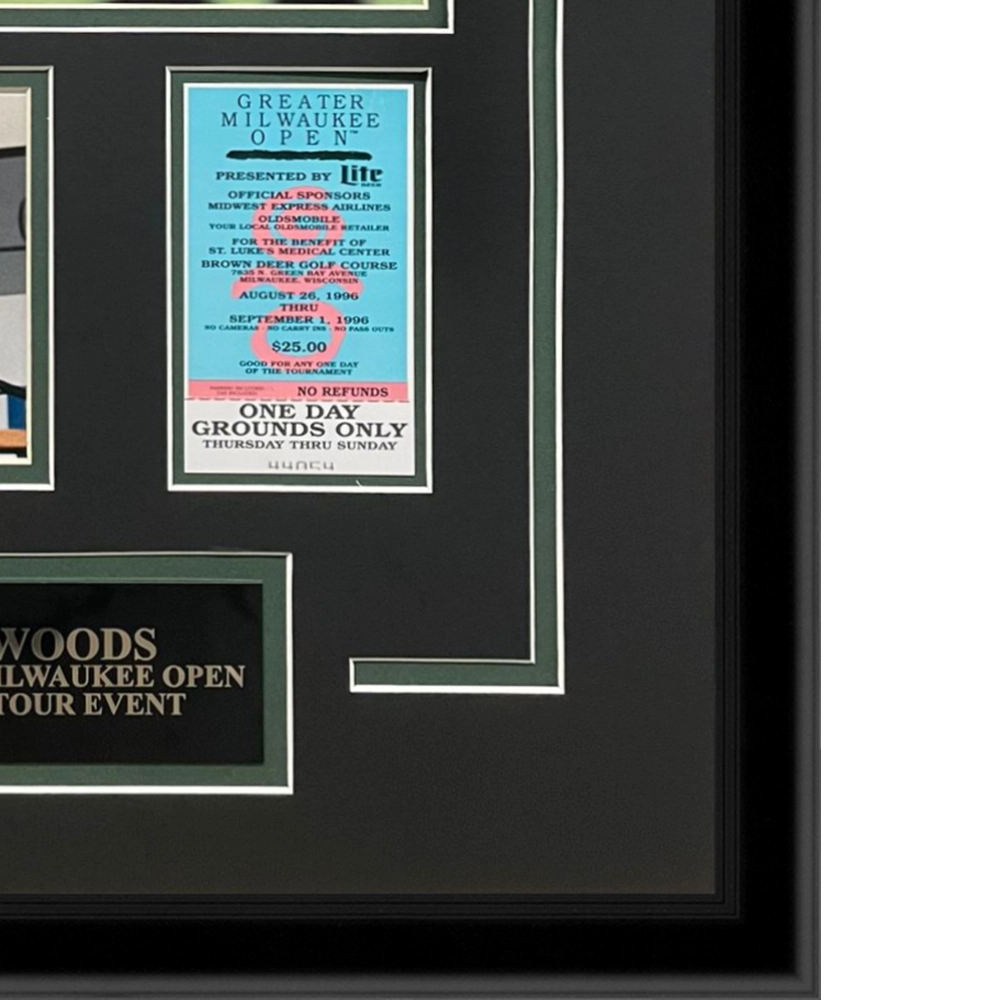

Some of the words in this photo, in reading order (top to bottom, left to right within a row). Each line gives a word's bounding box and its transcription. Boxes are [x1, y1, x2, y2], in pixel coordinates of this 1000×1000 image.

[237, 94, 364, 110] GREATER
[221, 112, 380, 128] MILWAUKEE
[216, 172, 306, 181] PRESENTED
[311, 172, 332, 181] BY
[340, 165, 384, 186] Lite
[228, 190, 293, 200] OFFICIAL
[297, 190, 371, 200] SPONSORS
[208, 203, 267, 211] MIDWEST
[271, 203, 328, 212] EXPRESS
[332, 203, 391, 212] AIRLINES
[258, 215, 340, 223] OLDSMOBILE
[232, 238, 258, 246] FOR
[263, 238, 288, 246] THE
[292, 238, 344, 246] BENEFIT
[349, 238, 367, 246] OF
[208, 247, 226, 255] ST.
[278, 248, 336, 256] MEDICAL
[339, 248, 390, 257] CENTER
[201, 260, 252, 269] BROWN
[256, 260, 294, 269] DEER
[299, 260, 336, 270] GOLF
[340, 261, 398, 270] COURSE
[239, 292, 293, 300] AUGUST
[326, 292, 359, 300] 1996
[280, 304, 318, 312] THRU
[229, 315, 314, 324] SEPTEMBER
[336, 316, 369, 325] 1996
[271, 341, 327, 353] $25.00
[297, 386, 317, 397] NO
[322, 386, 389, 397] REFUNDS
[239, 404, 296, 420] ONE
[306, 404, 361, 420] DAY
[192, 421, 325, 438] GROUNDS
[335, 422, 408, 438] ONLY
[202, 440, 285, 449] THURSDAY
[289, 440, 332, 450] THRU
[336, 441, 398, 451] SUNDAY
[162, 665, 246, 689] OPEN
[84, 693, 187, 717] EVENT
